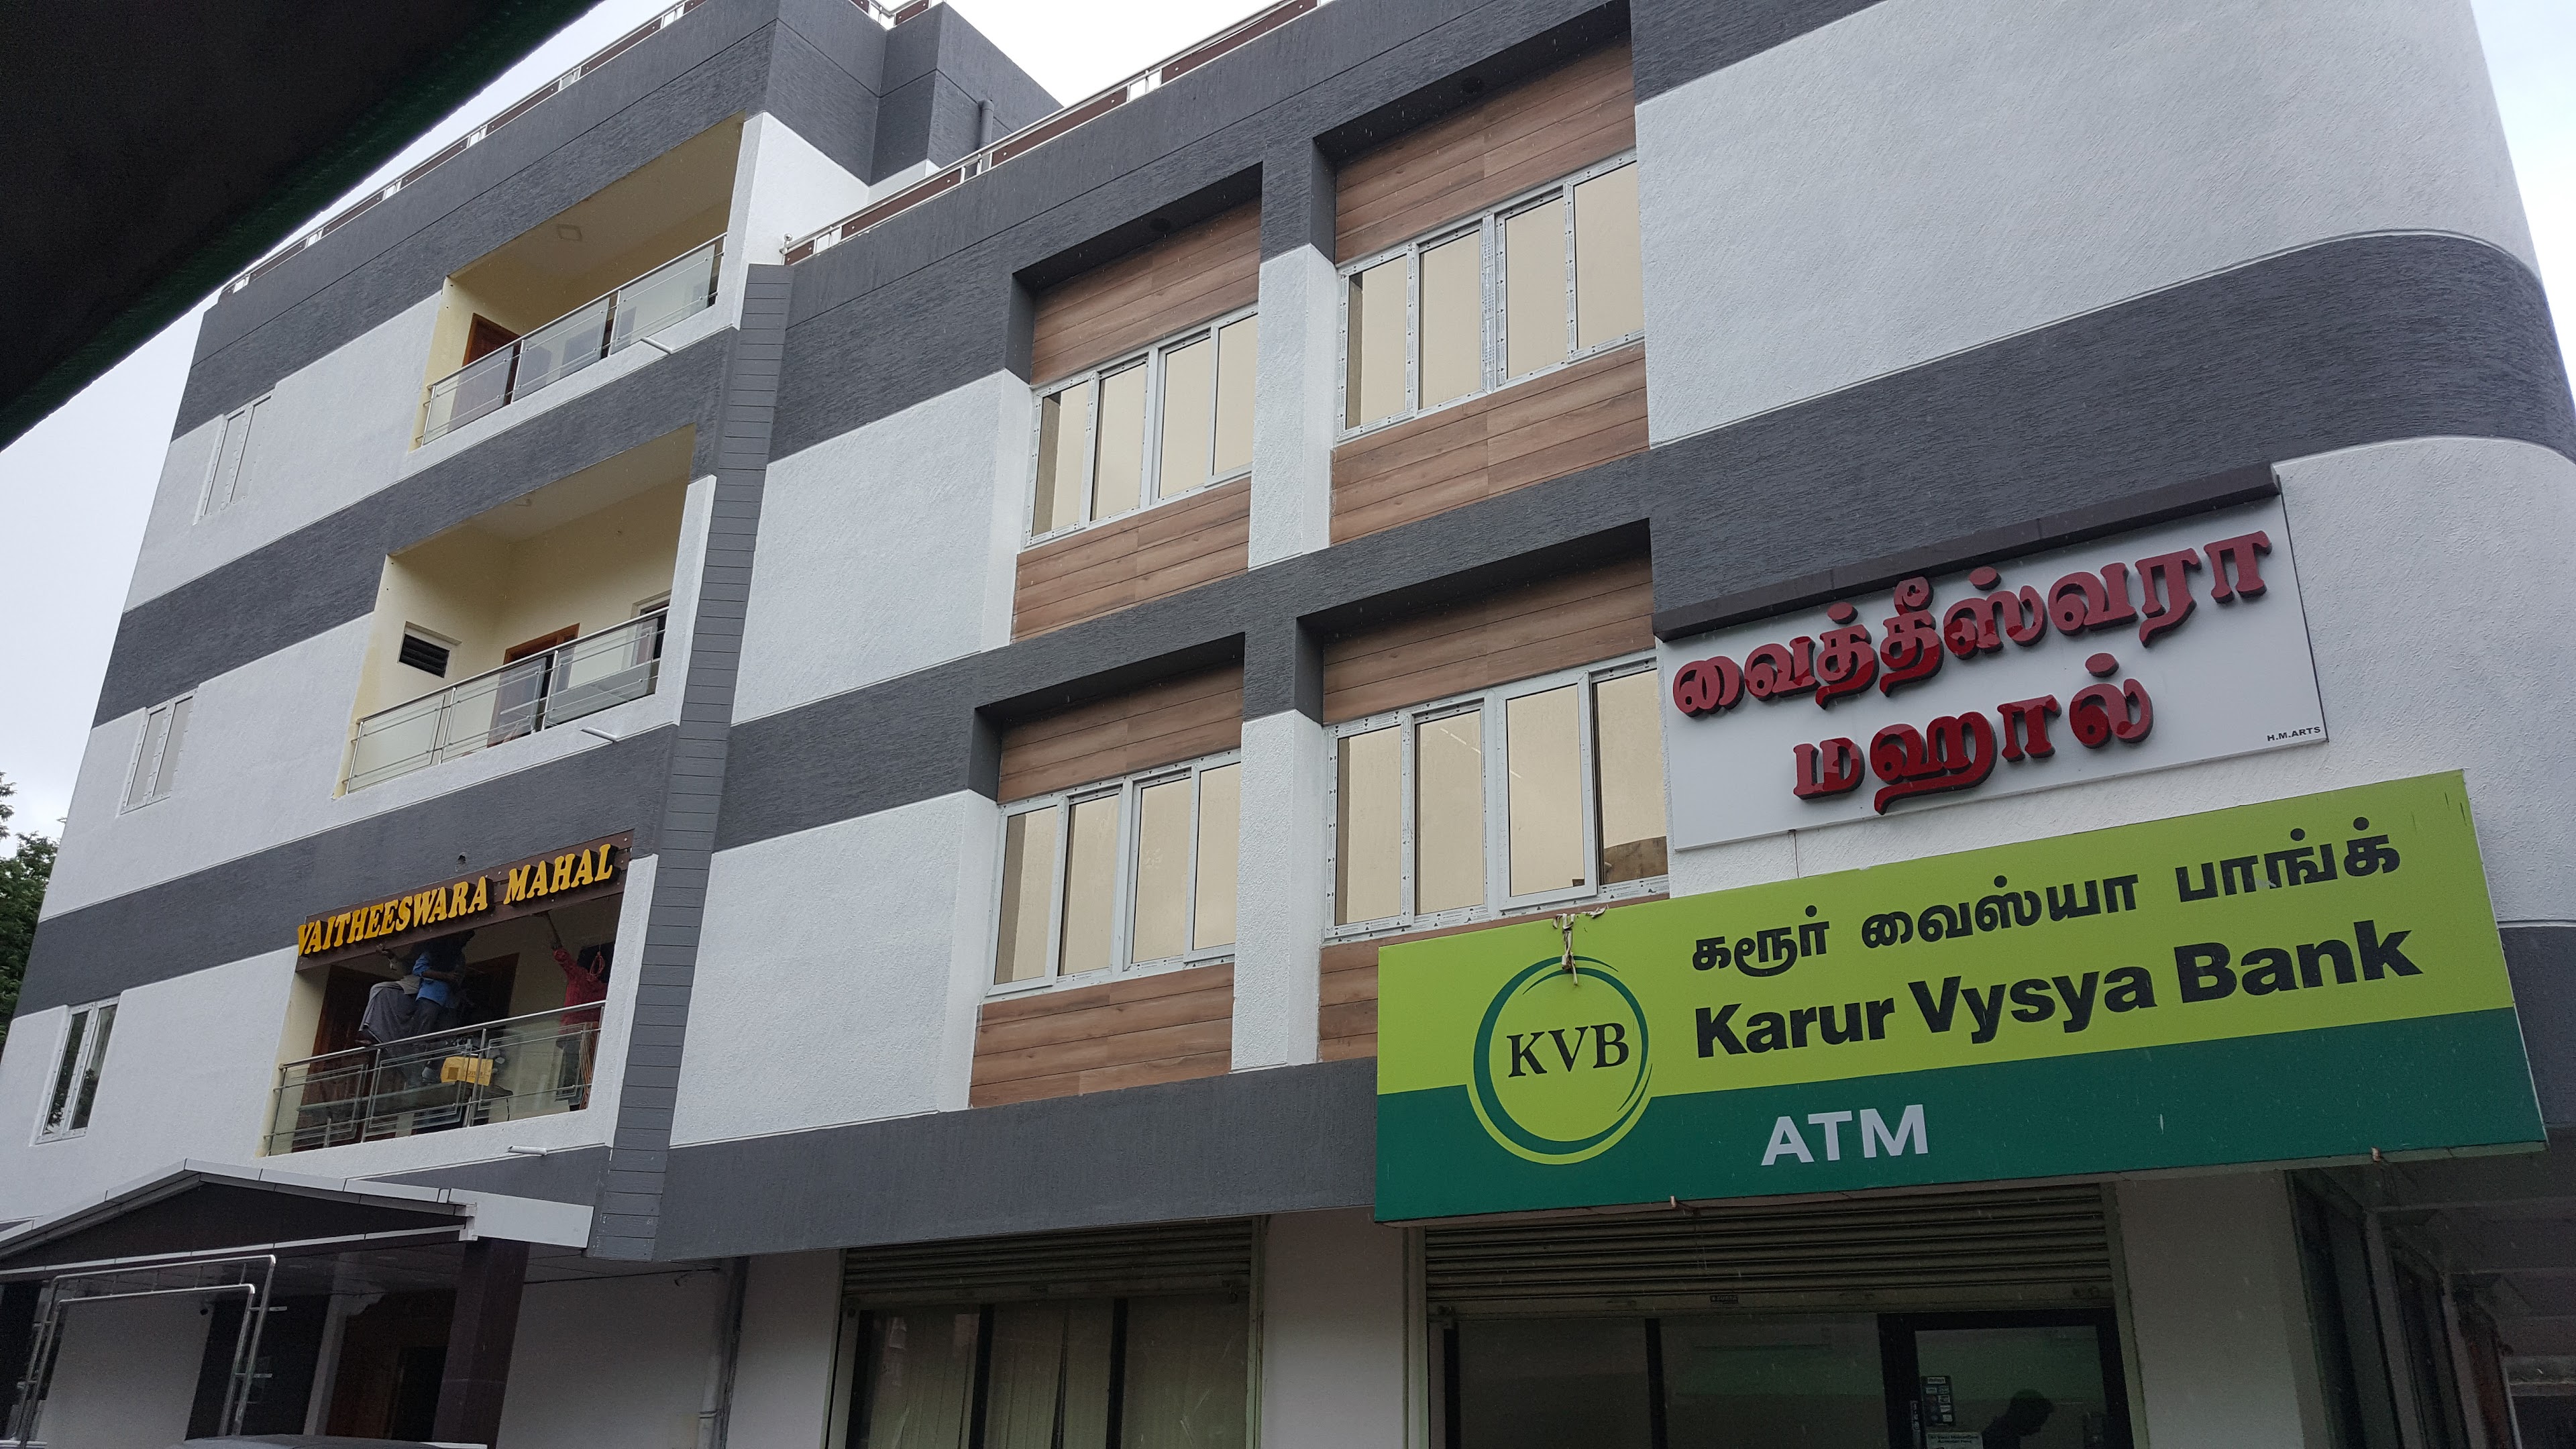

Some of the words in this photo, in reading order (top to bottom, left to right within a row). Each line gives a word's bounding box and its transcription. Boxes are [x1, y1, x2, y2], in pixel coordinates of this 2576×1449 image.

[1672, 531, 2271, 709] வைத்தீஸ்வரா
[1792, 652, 2153, 814] மஹால்
[2267, 727, 2321, 741] H.M.ARTS
[297, 875, 488, 957] VAITHEESWARA
[503, 843, 613, 905] MAHAL
[1692, 905, 1830, 978] கரூர்
[1861, 873, 2140, 949] வைஸ்யா
[2174, 814, 2402, 903] பாங்க்
[1506, 1022, 1630, 1079] KVB
[1695, 997, 1896, 1059] Karur
[1907, 966, 2158, 1044] Vysya
[2173, 919, 2424, 1004] Bank
[1761, 1104, 1929, 1167] ATM
